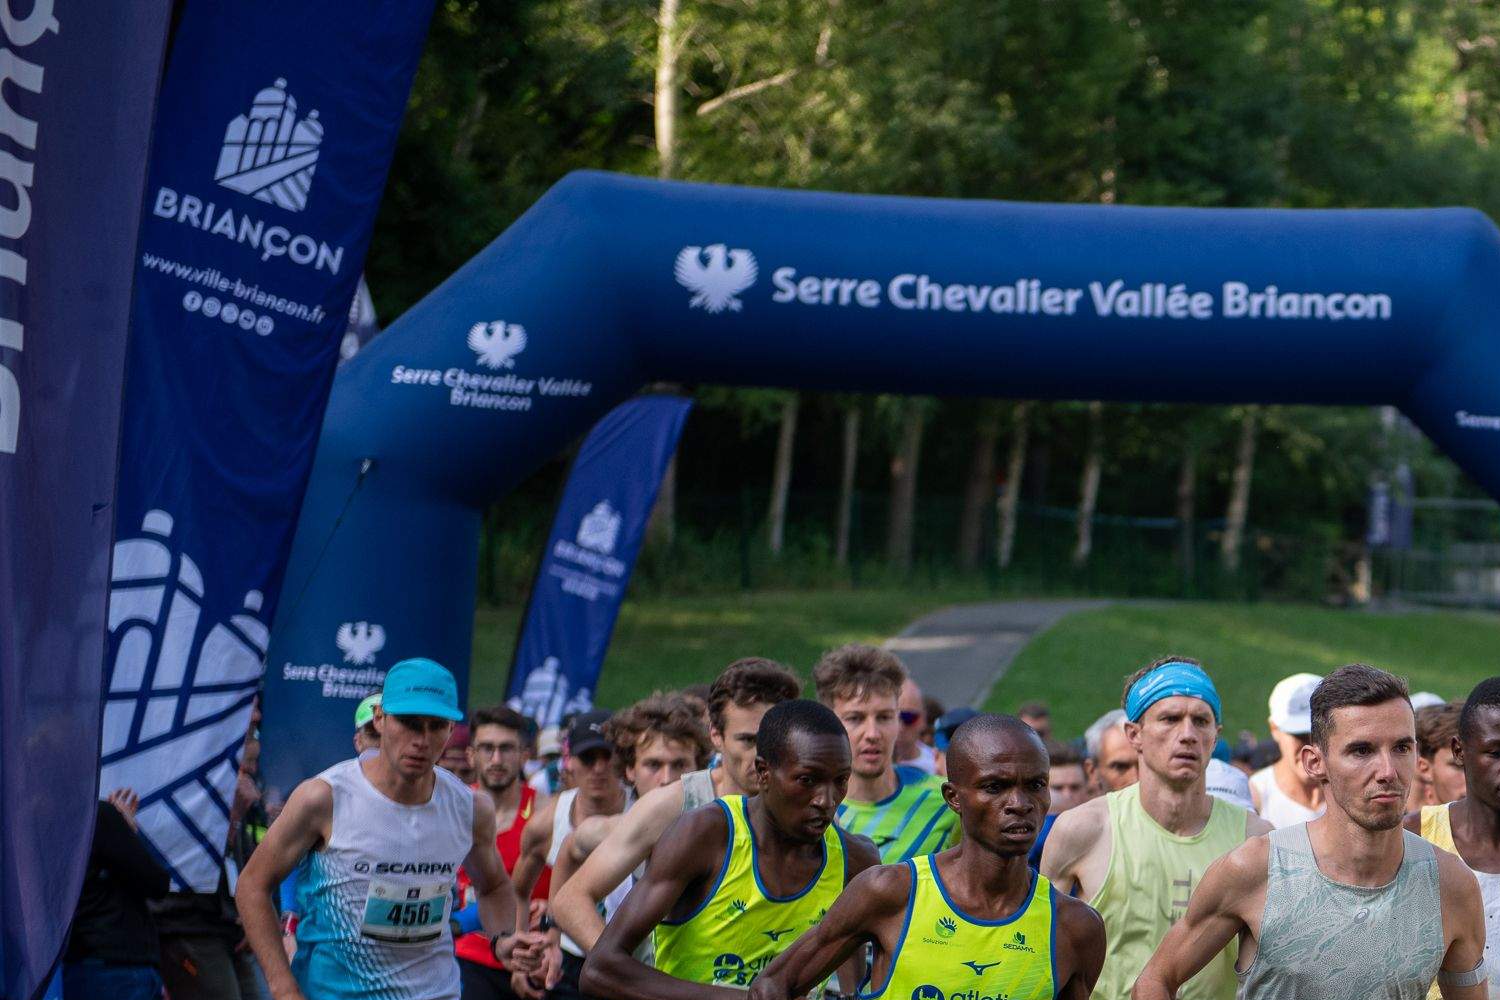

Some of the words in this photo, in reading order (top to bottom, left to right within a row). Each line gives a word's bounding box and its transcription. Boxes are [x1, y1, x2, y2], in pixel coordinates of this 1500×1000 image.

[153, 187, 344, 276] BRIANÇON
[143, 252, 326, 324] www.ville-briancon.fr
[773, 267, 882, 308] Serre
[889, 274, 1083, 315] Chevalier
[1090, 280, 1213, 318] Vallée
[391, 365, 441, 385] Serre
[443, 368, 535, 393] Chevalier
[375, 861, 454, 875] SCARPA
[388, 902, 431, 926] 456
